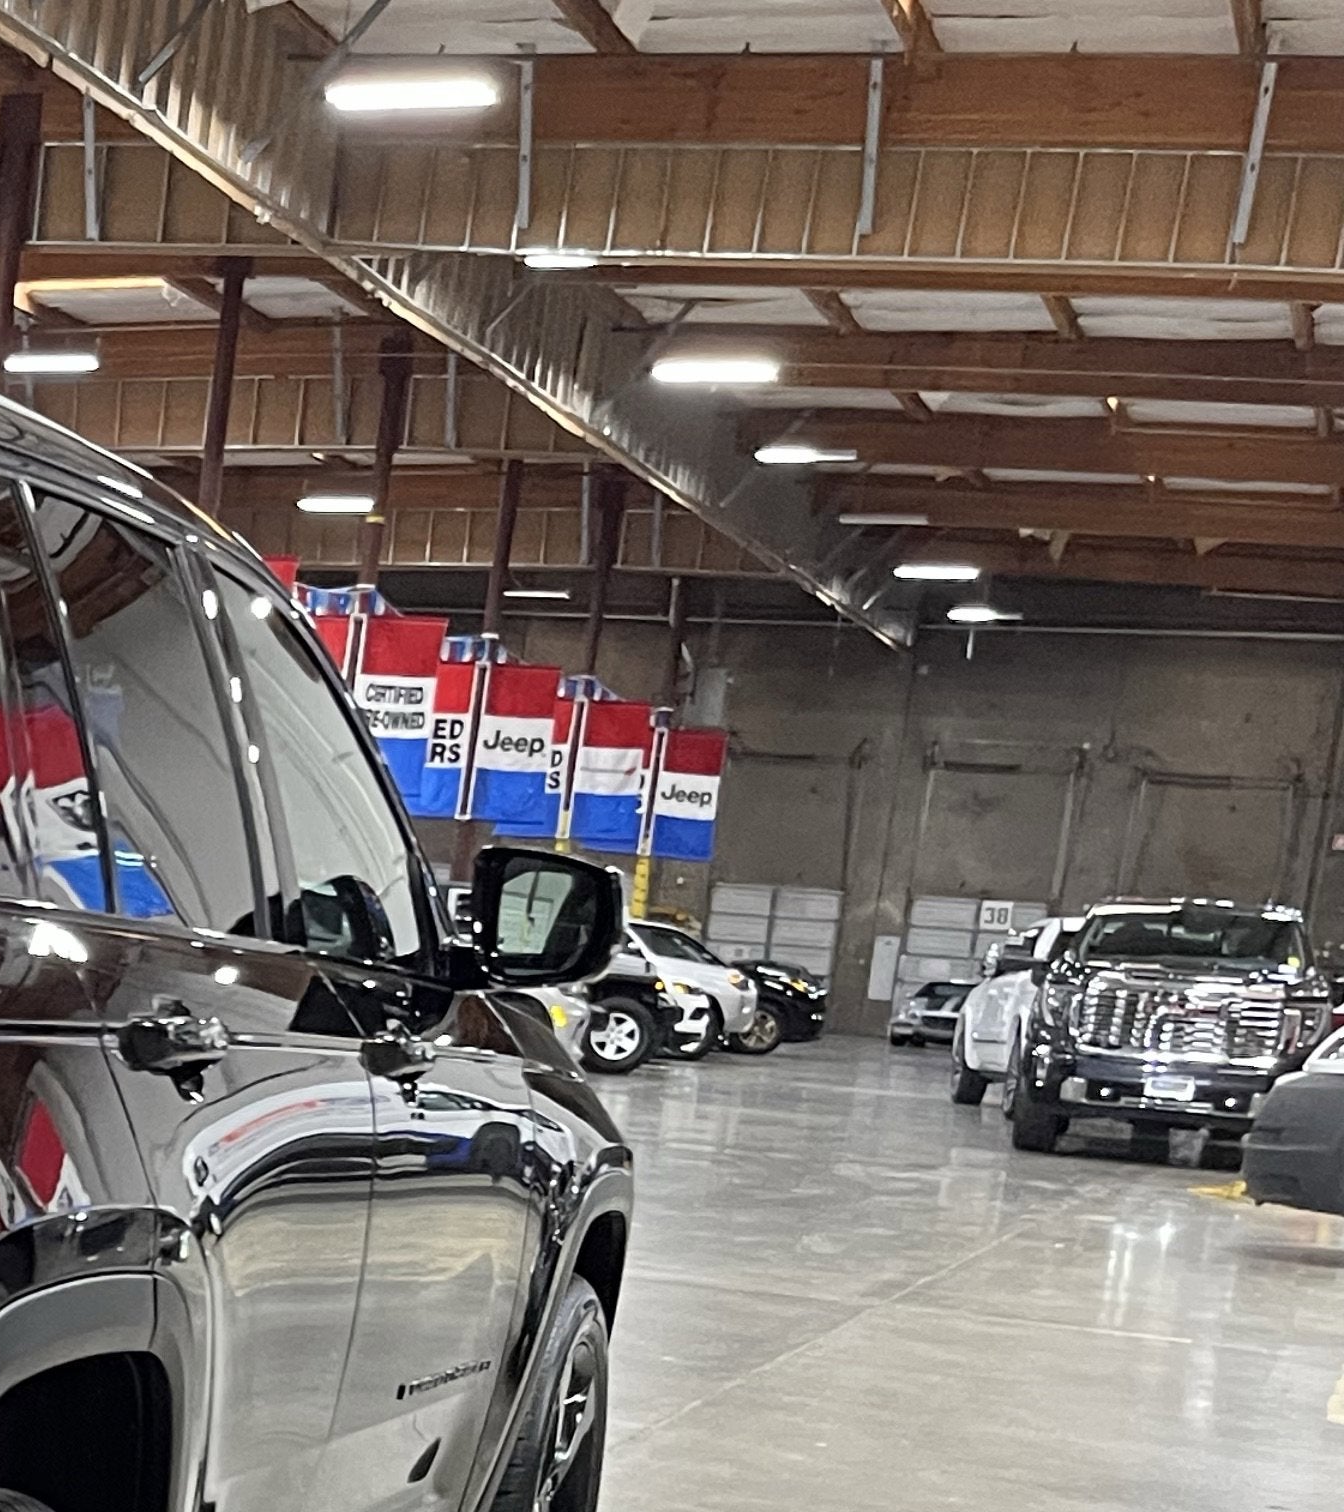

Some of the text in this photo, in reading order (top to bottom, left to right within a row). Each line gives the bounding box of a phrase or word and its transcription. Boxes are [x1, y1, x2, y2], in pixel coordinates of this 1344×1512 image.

[483, 730, 545, 757] Jeep
[661, 784, 712, 807] Jeep
[984, 907, 1009, 925] 38
